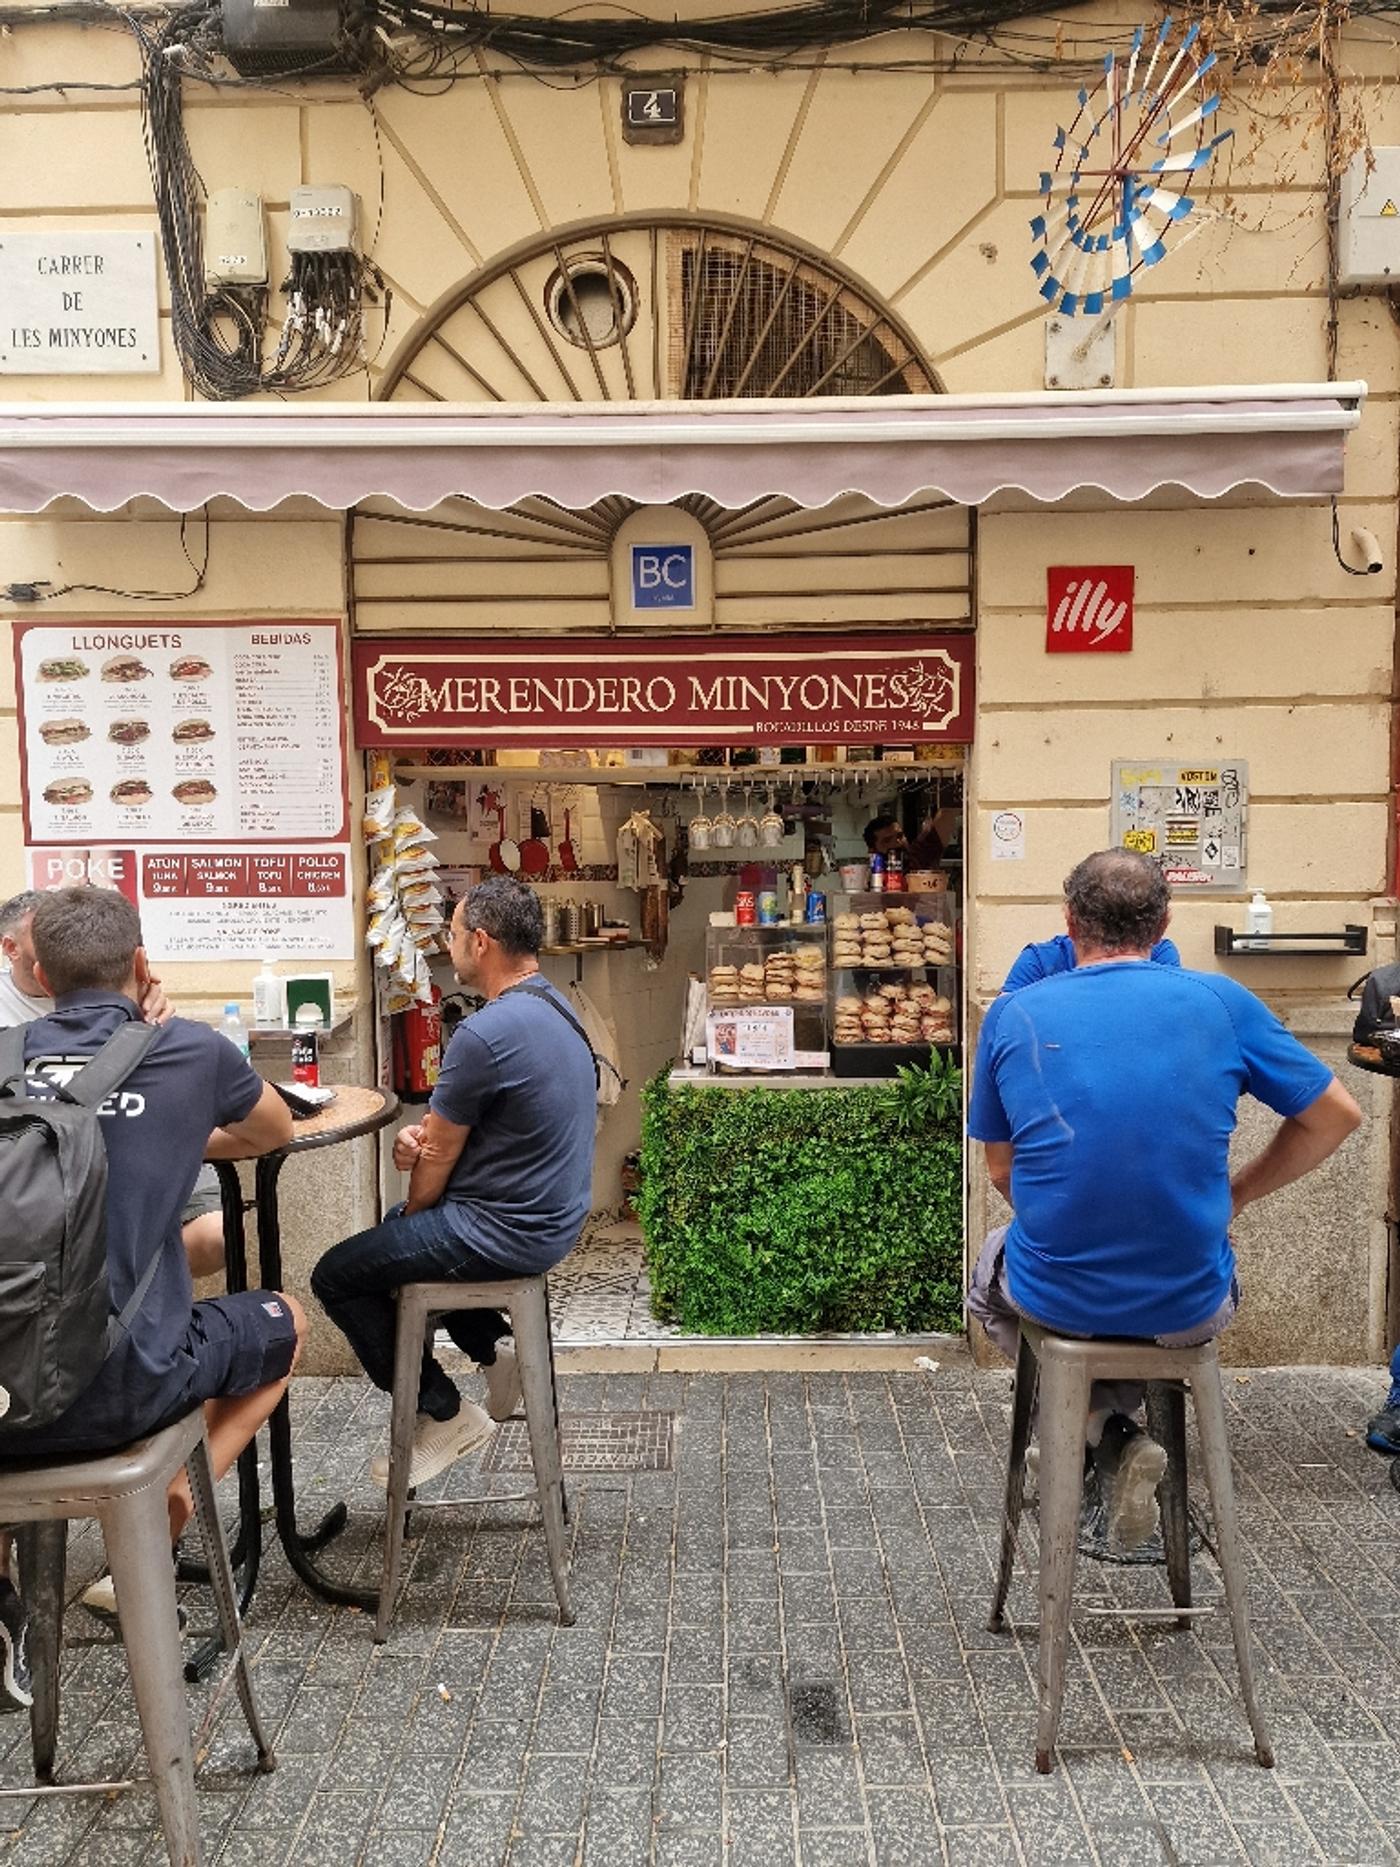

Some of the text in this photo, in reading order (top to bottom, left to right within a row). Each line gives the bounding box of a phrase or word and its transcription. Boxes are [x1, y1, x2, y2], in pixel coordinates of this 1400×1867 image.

[643, 93, 661, 118] 4
[38, 255, 104, 275] CARRER
[62, 292, 83, 311] DE
[12, 328, 137, 348] LES MINYONES
[640, 554, 686, 588] BC
[1052, 579, 1128, 645] illy
[72, 634, 182, 650] LLONGUETS
[251, 632, 311, 645] BEBIDAS
[418, 674, 911, 713] MERENDERO MINYONES
[756, 720, 840, 732] BOCADILLOS
[843, 720, 887, 732] DESDE
[47, 858, 125, 879] POKE
[253, 858, 286, 868] TOFU
[299, 857, 339, 867] POLLO
[257, 872, 282, 881] TOFU
